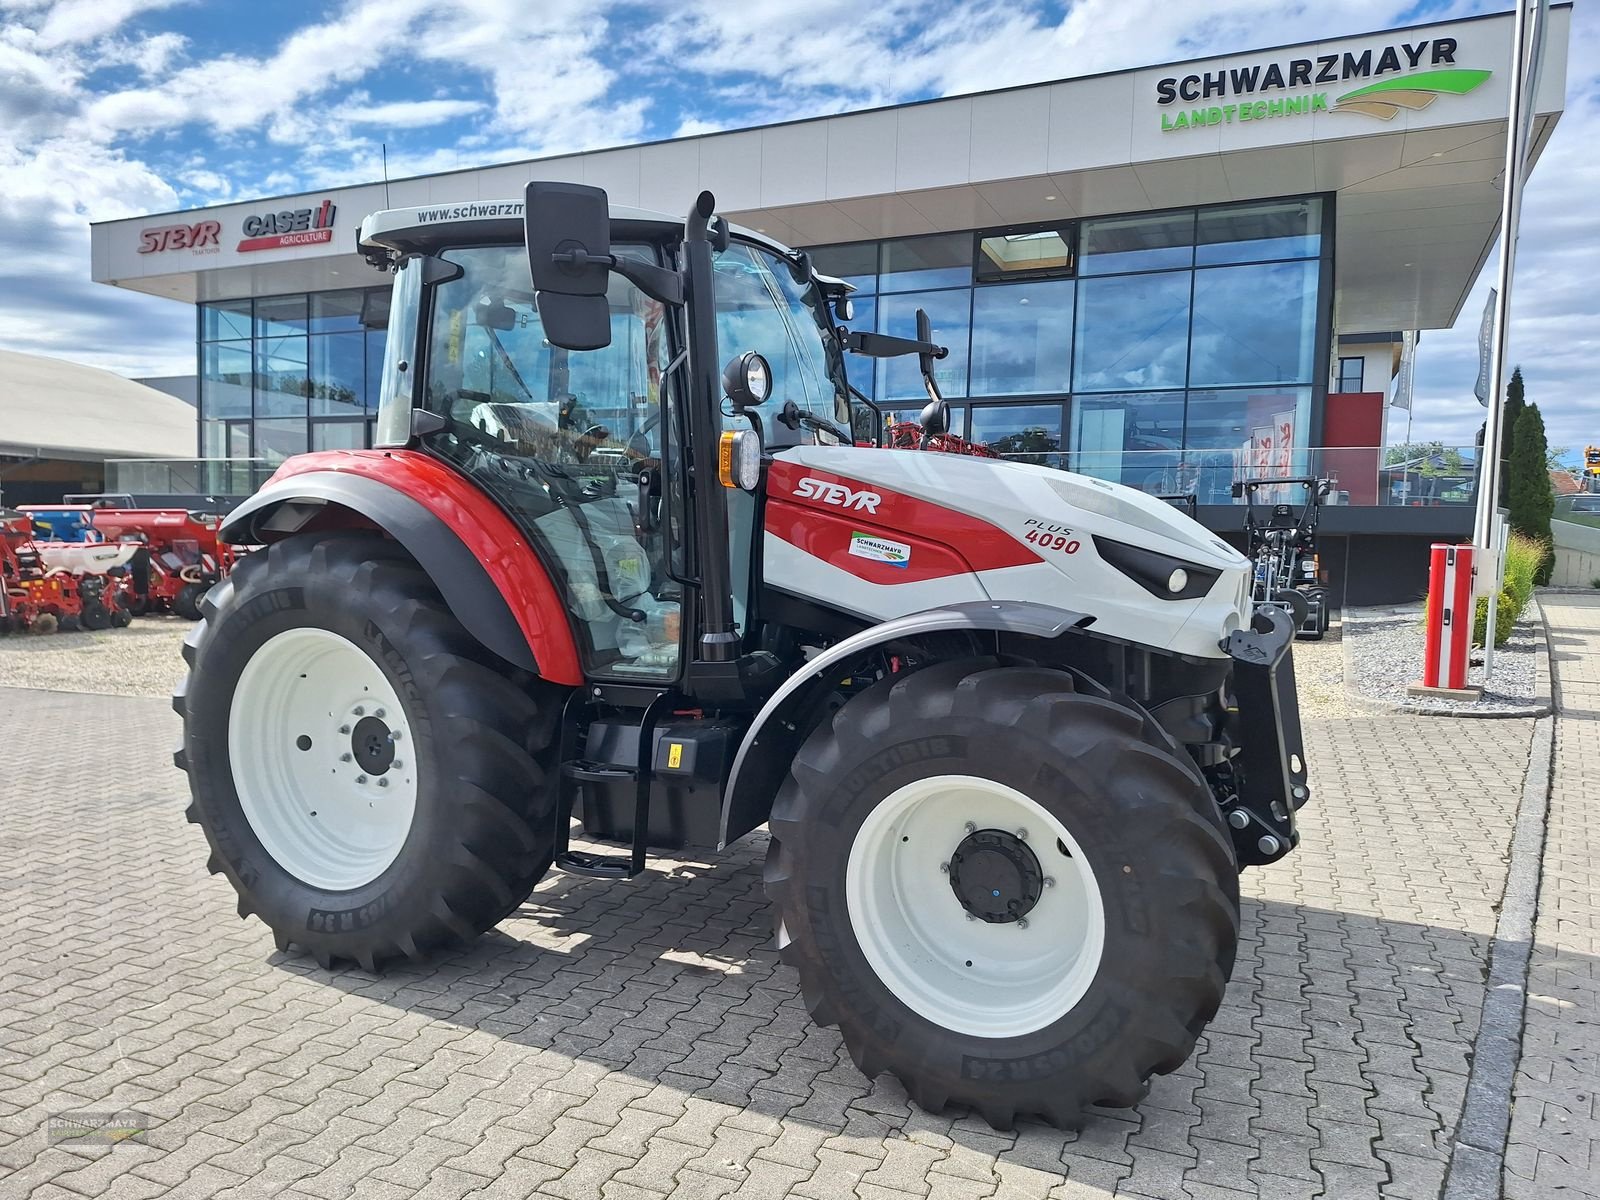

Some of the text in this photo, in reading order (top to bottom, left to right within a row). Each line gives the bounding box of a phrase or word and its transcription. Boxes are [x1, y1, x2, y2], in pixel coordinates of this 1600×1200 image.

[1156, 37, 1458, 105] SCHWARZMAYR
[1161, 92, 1328, 131] LANDTECHNIK
[137, 220, 222, 254] STEYR
[242, 208, 312, 237] CASE
[279, 231, 328, 246] AGRICULTURE
[792, 477, 881, 515] STEYR
[1024, 519, 1074, 536] PLUS
[1025, 530, 1081, 554] 4090
[856, 538, 902, 554] SCHWARZMAYR
